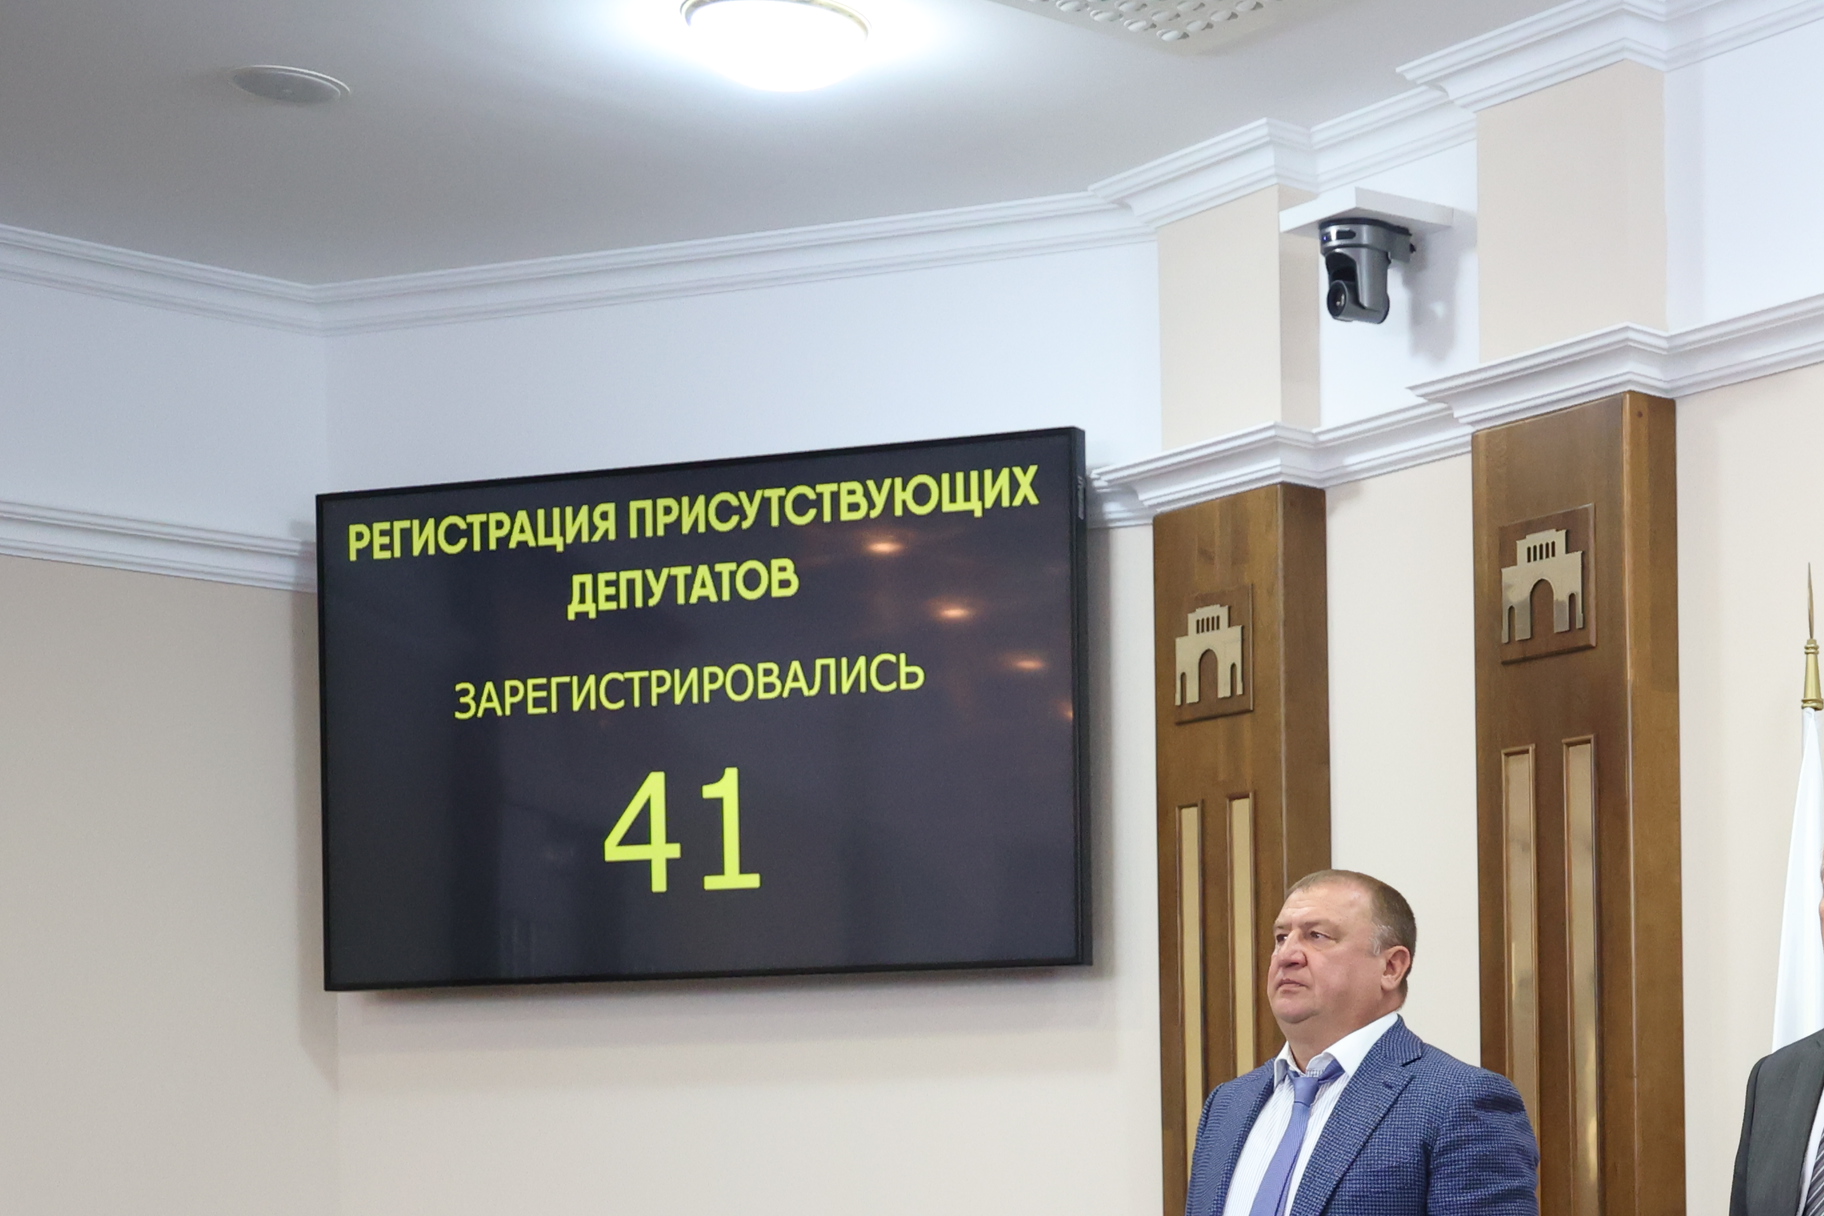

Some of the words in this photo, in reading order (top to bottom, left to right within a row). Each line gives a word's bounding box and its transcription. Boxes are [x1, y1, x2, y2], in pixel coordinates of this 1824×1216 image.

[348, 502, 617, 562] РЕГИСТРАЦИЯ
[628, 464, 1040, 539] ПРИСУТСТВУЮЩИХ
[567, 557, 800, 621] ДЕПУТАТОВ
[454, 652, 925, 720] ЗАРЕГИСТРИРОВАЛИСЬ
[603, 766, 761, 893] 41
